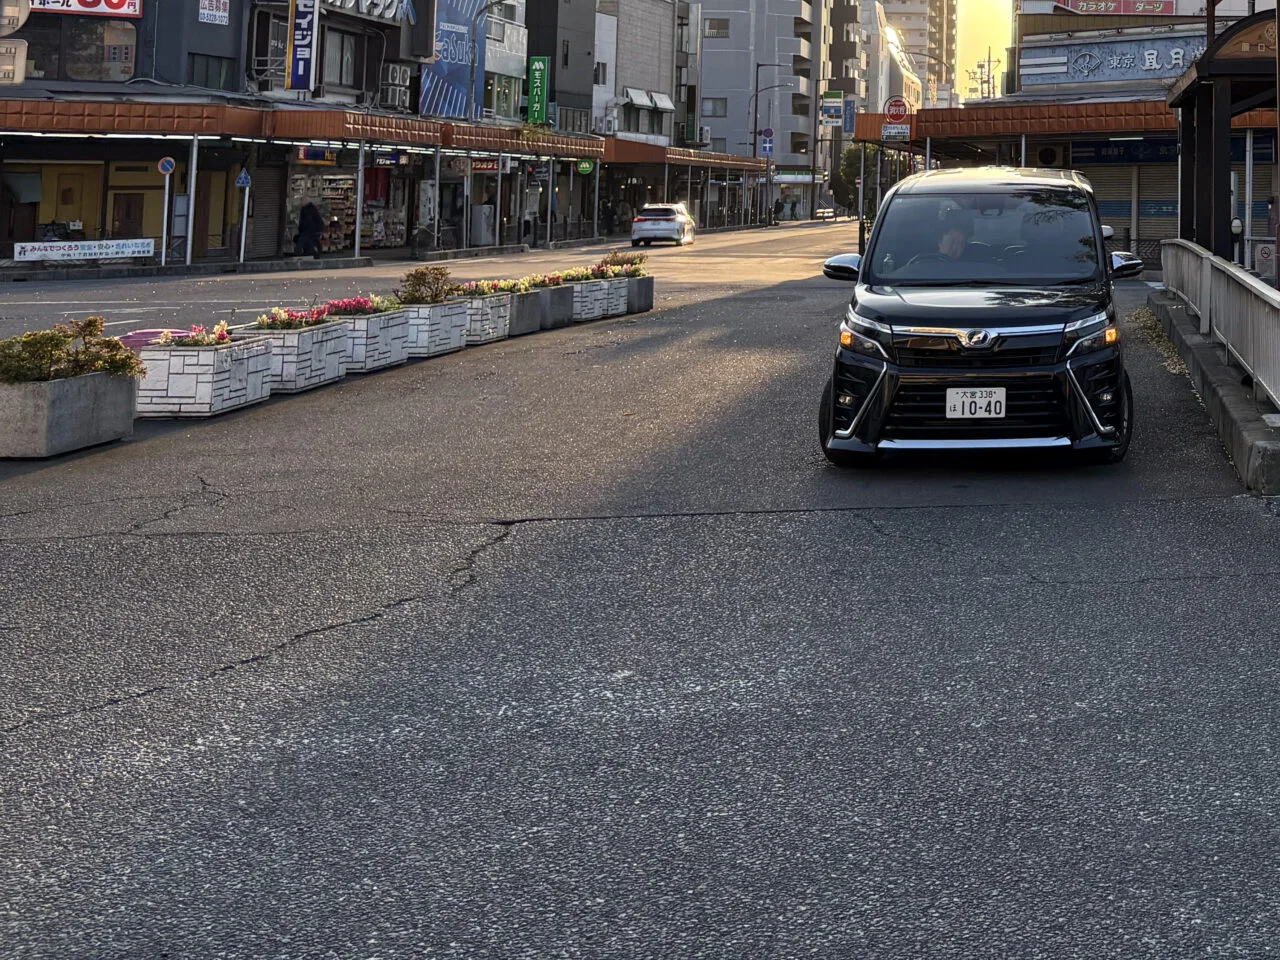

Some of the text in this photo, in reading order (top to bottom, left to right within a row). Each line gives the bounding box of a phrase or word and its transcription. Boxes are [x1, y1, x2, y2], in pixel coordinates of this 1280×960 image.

[1109, 54, 1135, 70] 東京
[532, 71, 542, 119] モスバーガー
[961, 391, 993, 399] 大宮 338
[962, 400, 1002, 416] 10-40
